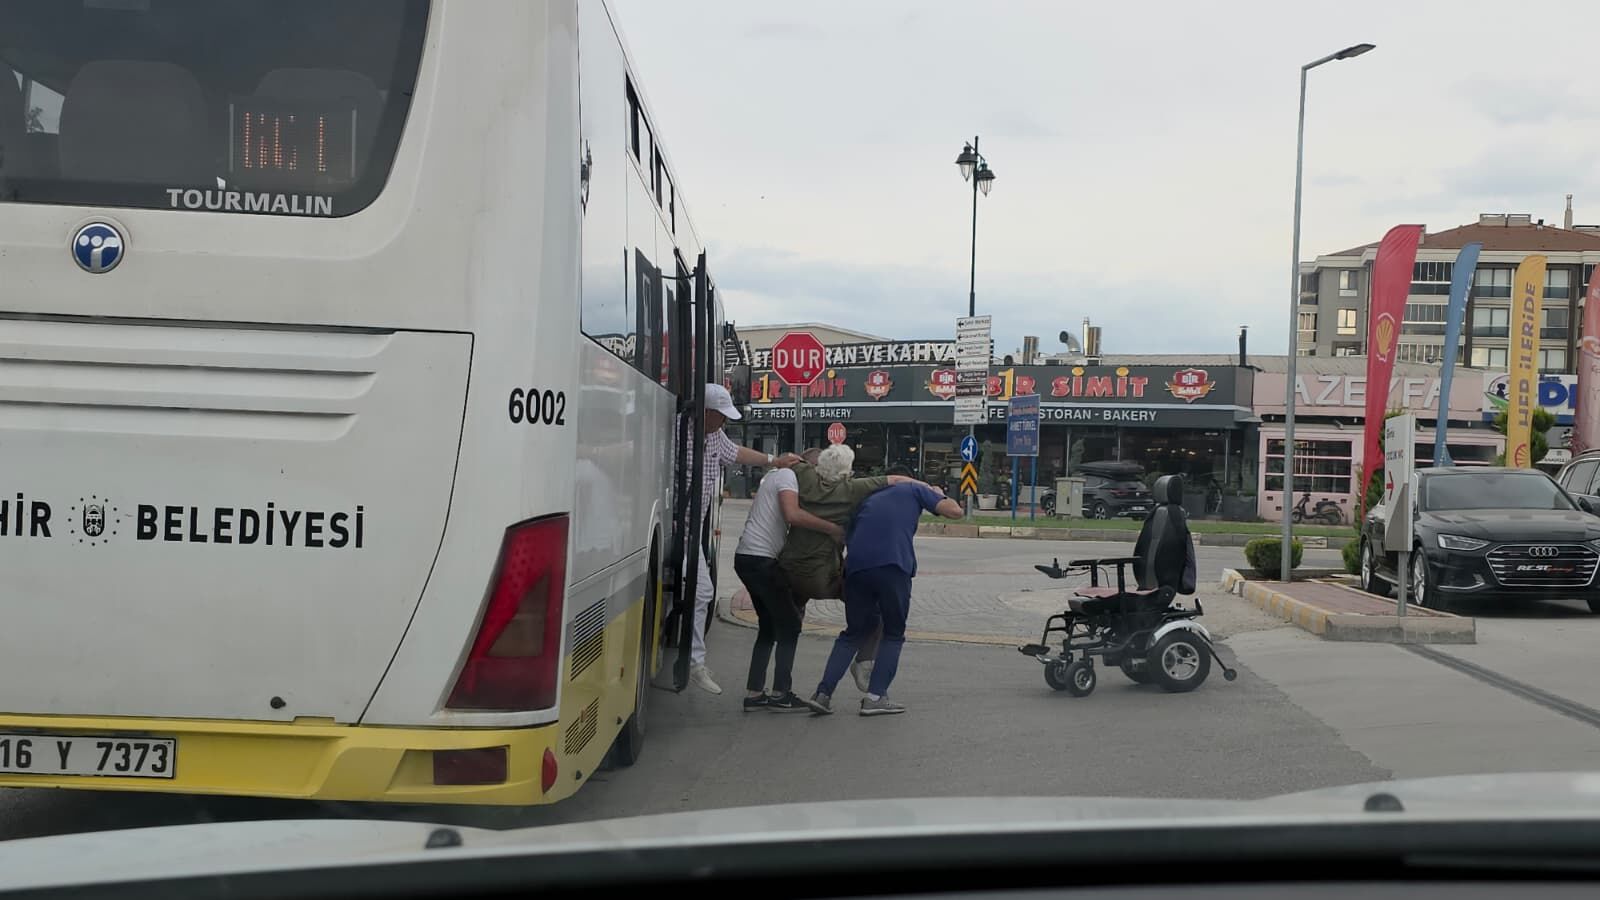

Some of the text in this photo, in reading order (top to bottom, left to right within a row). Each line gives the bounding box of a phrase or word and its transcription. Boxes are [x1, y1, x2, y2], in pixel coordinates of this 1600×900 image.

[166, 188, 333, 215] TOURMALIN
[777, 349, 821, 369] DUR
[863, 344, 885, 363] VE
[887, 342, 957, 362] KAHVA
[1051, 366, 1149, 398] SİMİT
[509, 388, 566, 426] 6002
[770, 409, 812, 418] RESTOAN
[820, 409, 852, 418] BAKERY
[988, 408, 1005, 419] FE
[1039, 408, 1092, 420] STORAN
[1103, 410, 1158, 421] BAKERY
[136, 501, 364, 549] BELEDİYESİ
[0, 738, 169, 773] 16 Y 7373
